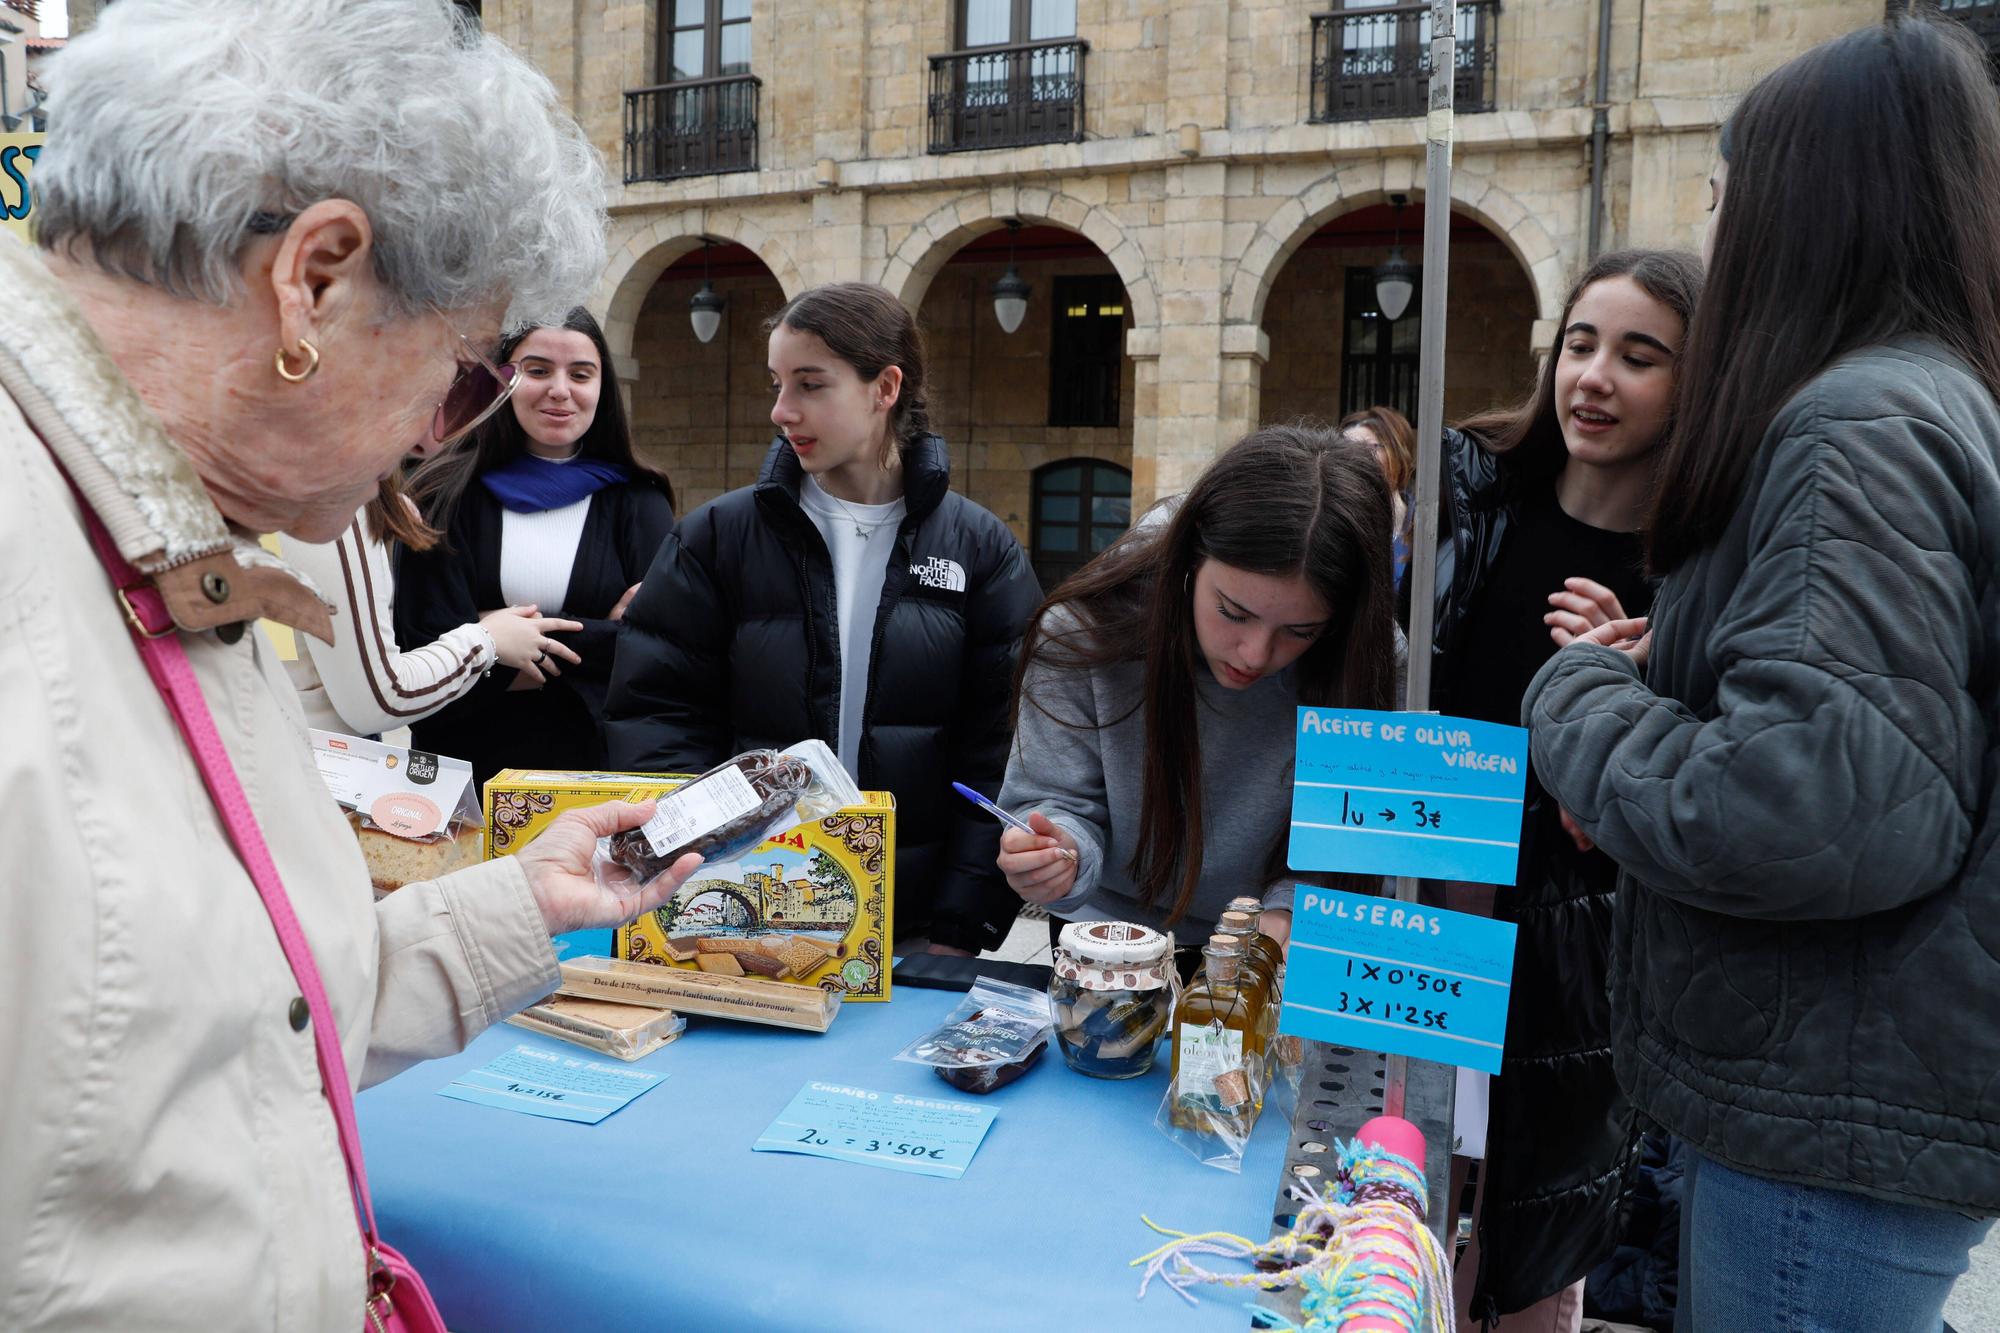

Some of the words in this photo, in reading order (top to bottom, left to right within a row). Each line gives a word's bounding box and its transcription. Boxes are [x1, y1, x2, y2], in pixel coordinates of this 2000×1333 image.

[927, 556, 949, 569] THE
[909, 564, 948, 579] NORTH
[919, 575, 947, 589] FACE
[1381, 723, 1407, 743] DE
[408, 768, 434, 779] ORIGEN
[391, 806, 423, 821] ORIGINAL
[1411, 800, 1441, 828] 3€
[1304, 893, 1441, 936] PULSERAS
[594, 977, 608, 986] Des
[610, 979, 619, 988] de
[755, 1001, 796, 1013] torronaire
